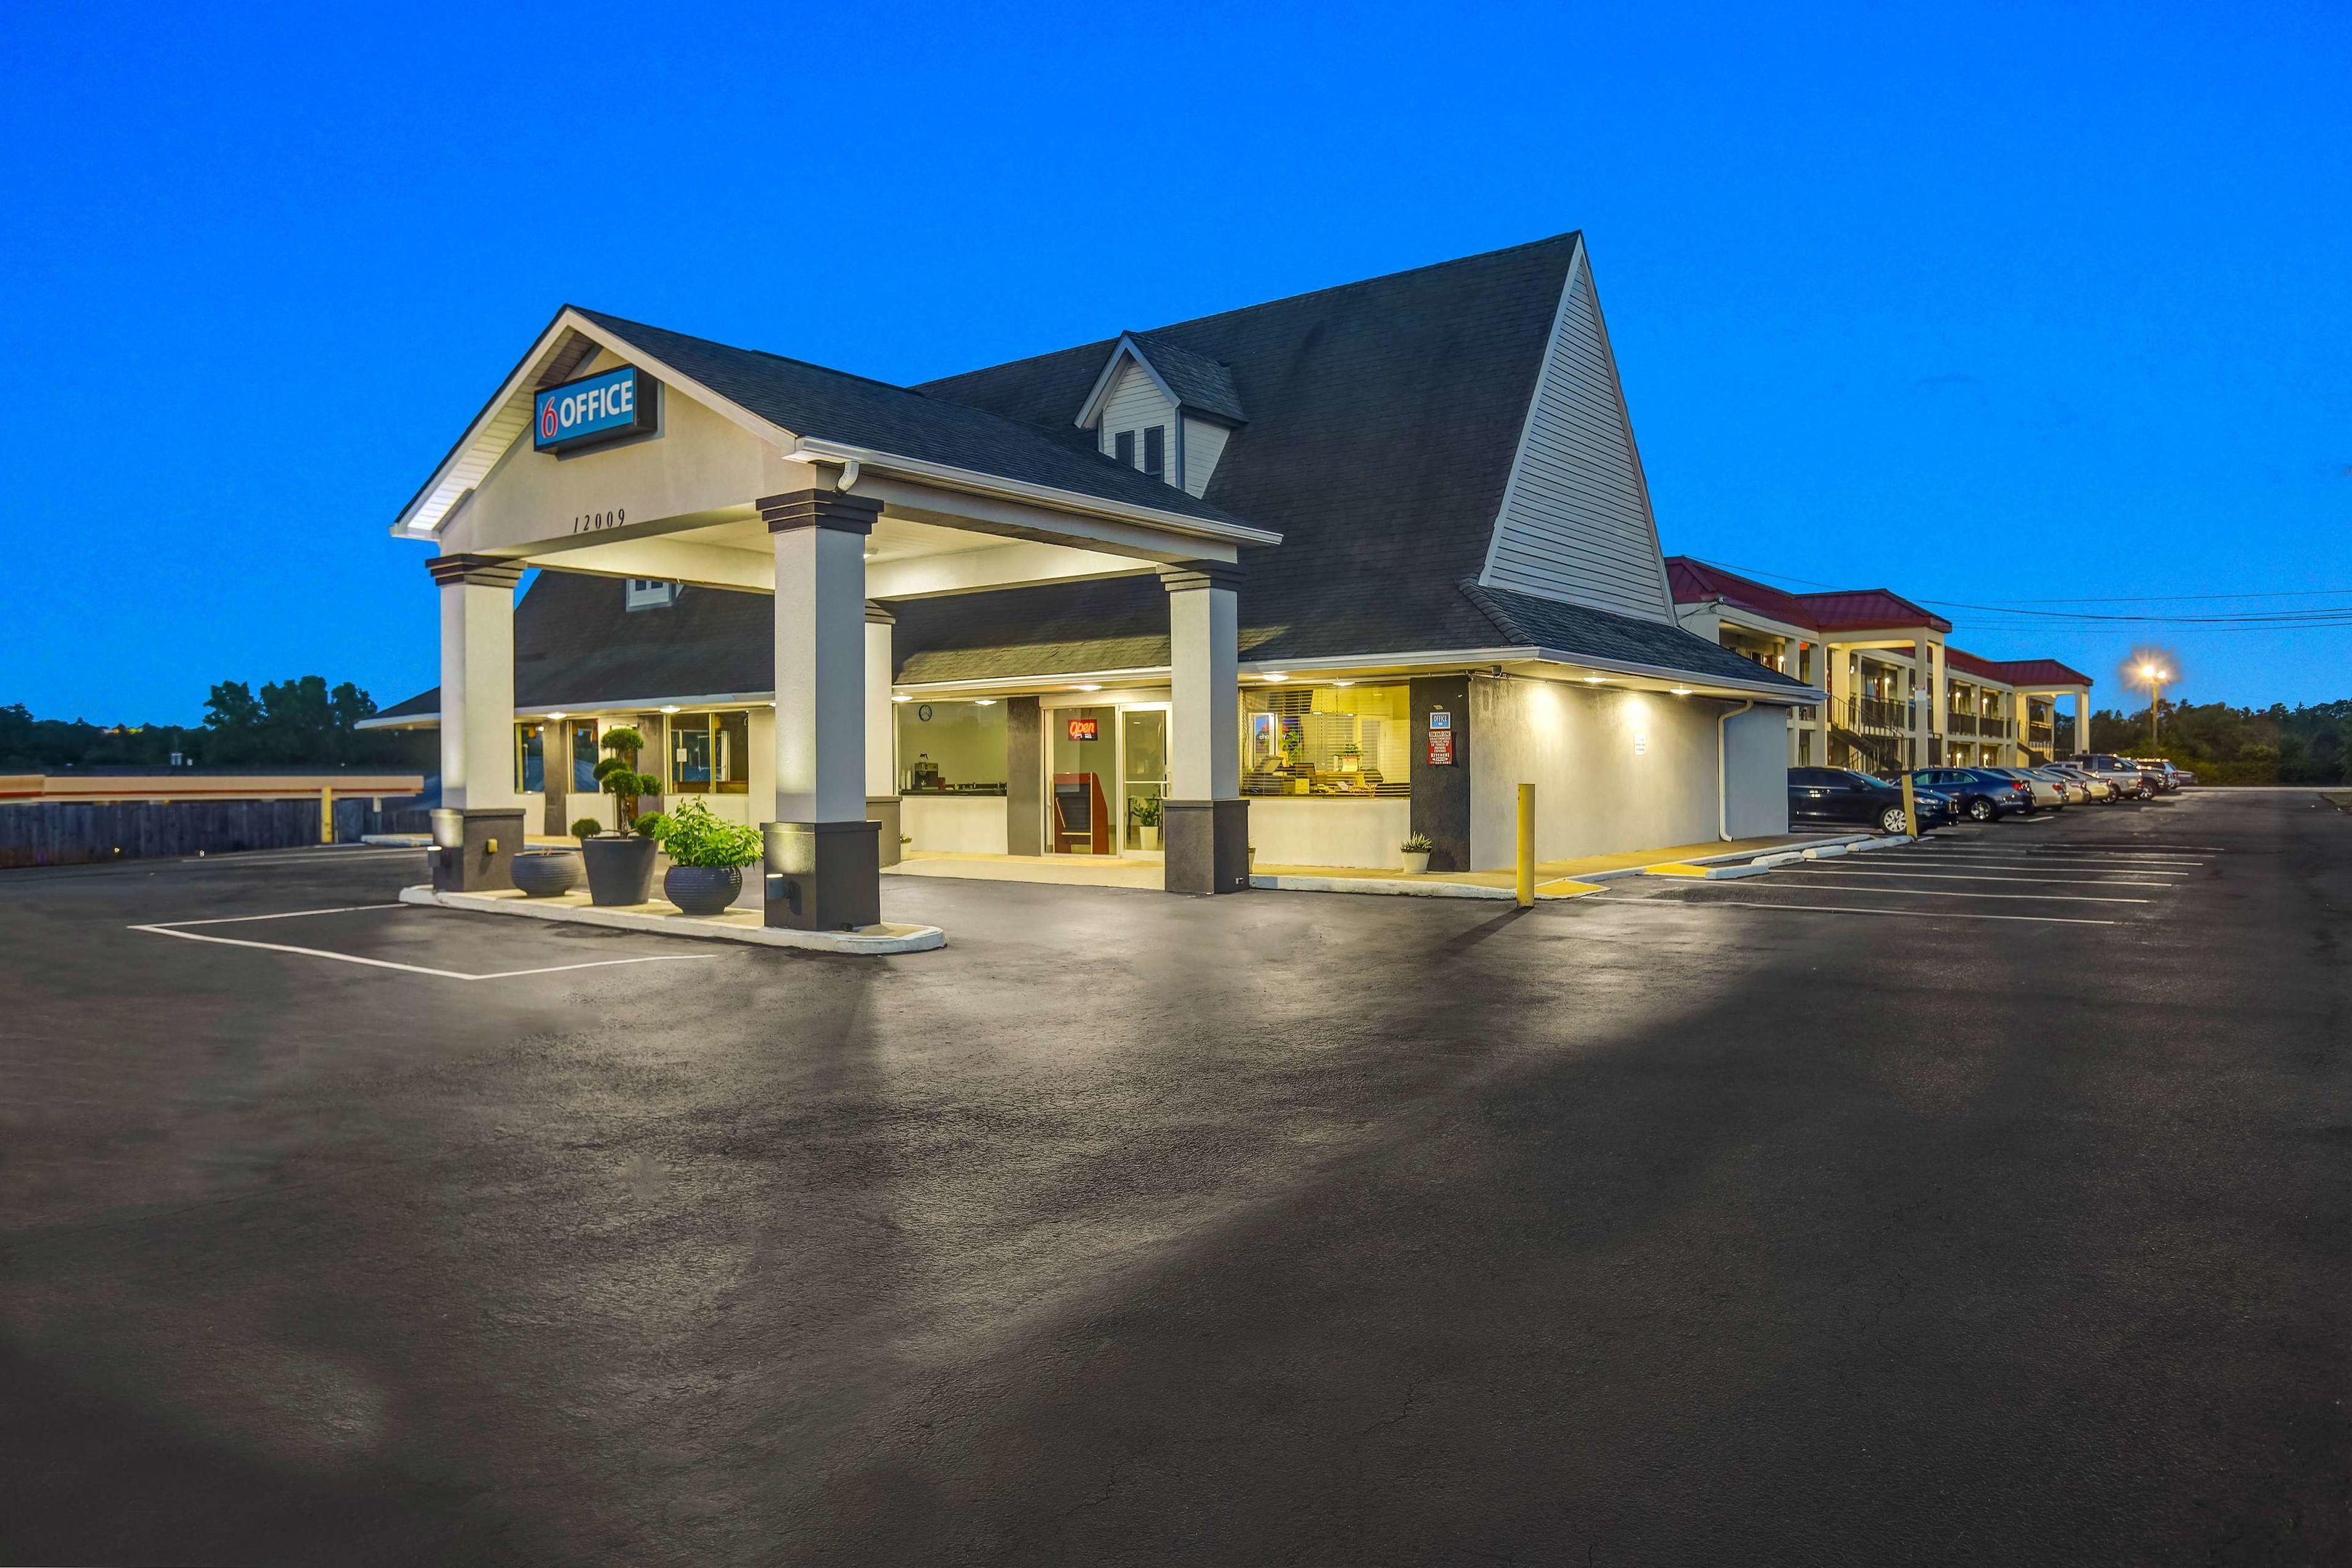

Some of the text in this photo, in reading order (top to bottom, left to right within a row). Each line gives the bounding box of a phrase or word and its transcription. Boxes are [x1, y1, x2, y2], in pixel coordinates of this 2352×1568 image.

[542, 380, 633, 438] 6 OFFICE
[573, 508, 624, 534] 12009
